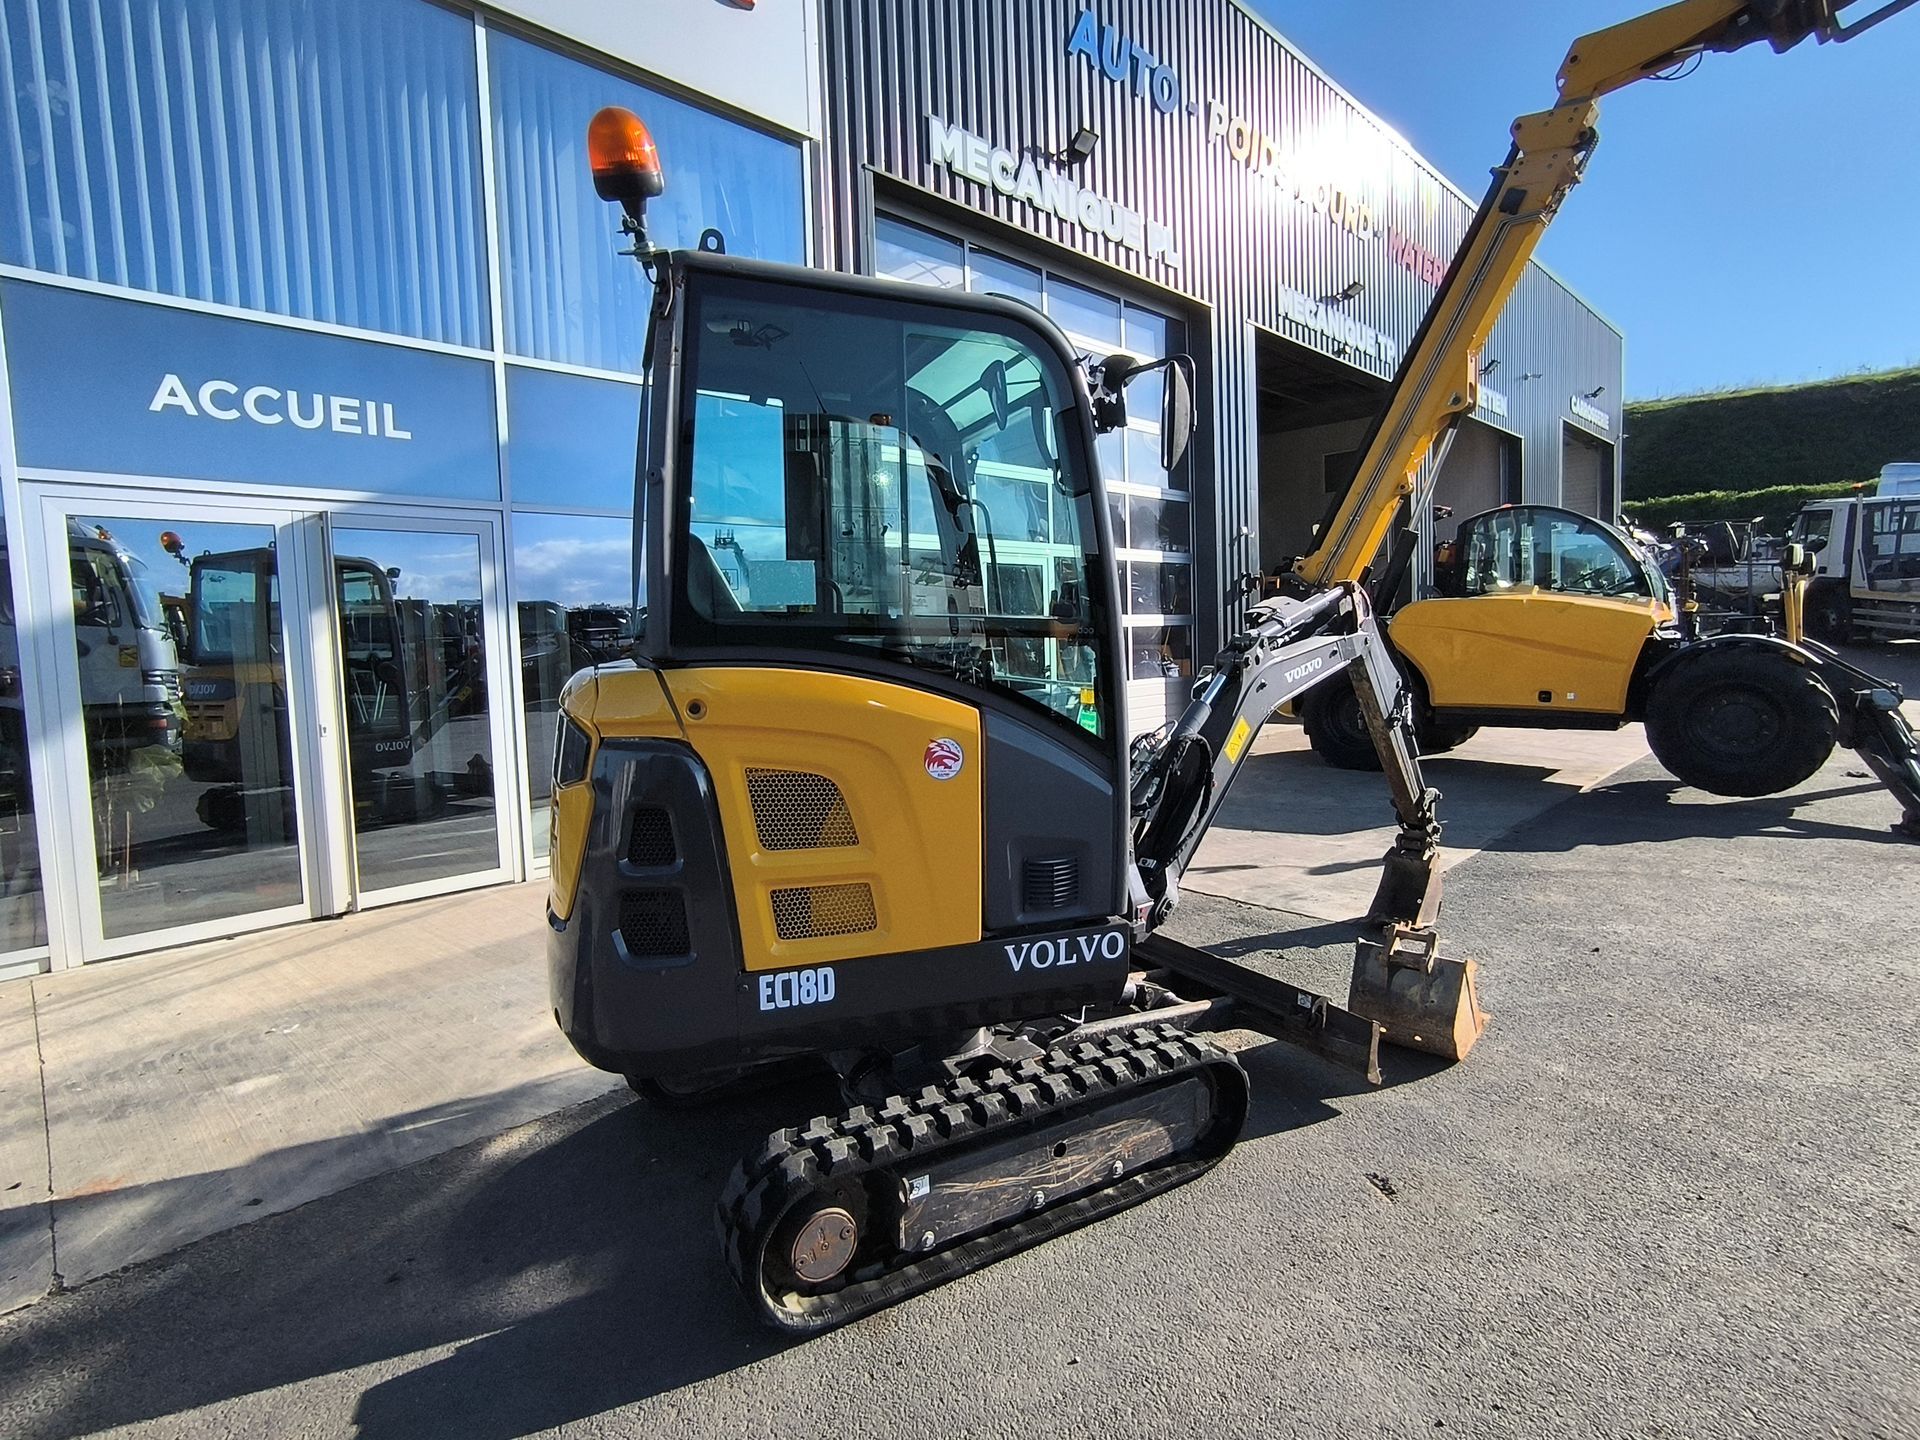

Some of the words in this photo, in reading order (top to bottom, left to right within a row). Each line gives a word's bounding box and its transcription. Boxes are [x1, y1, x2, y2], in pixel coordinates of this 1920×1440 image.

[1067, 8, 1180, 114] AUTO
[1294, 170, 1374, 241] OURD
[1387, 226, 1450, 288] MATER
[928, 114, 1143, 252] MECANIQUE
[1146, 217, 1181, 269] PL
[1279, 284, 1377, 356] MECANIQUE
[1375, 330, 1397, 363] TP
[149, 373, 412, 440] ACCUEIL
[1284, 657, 1323, 684] VOLVO
[1004, 931, 1125, 972] VOLVO
[759, 967, 836, 1011] EC18D
